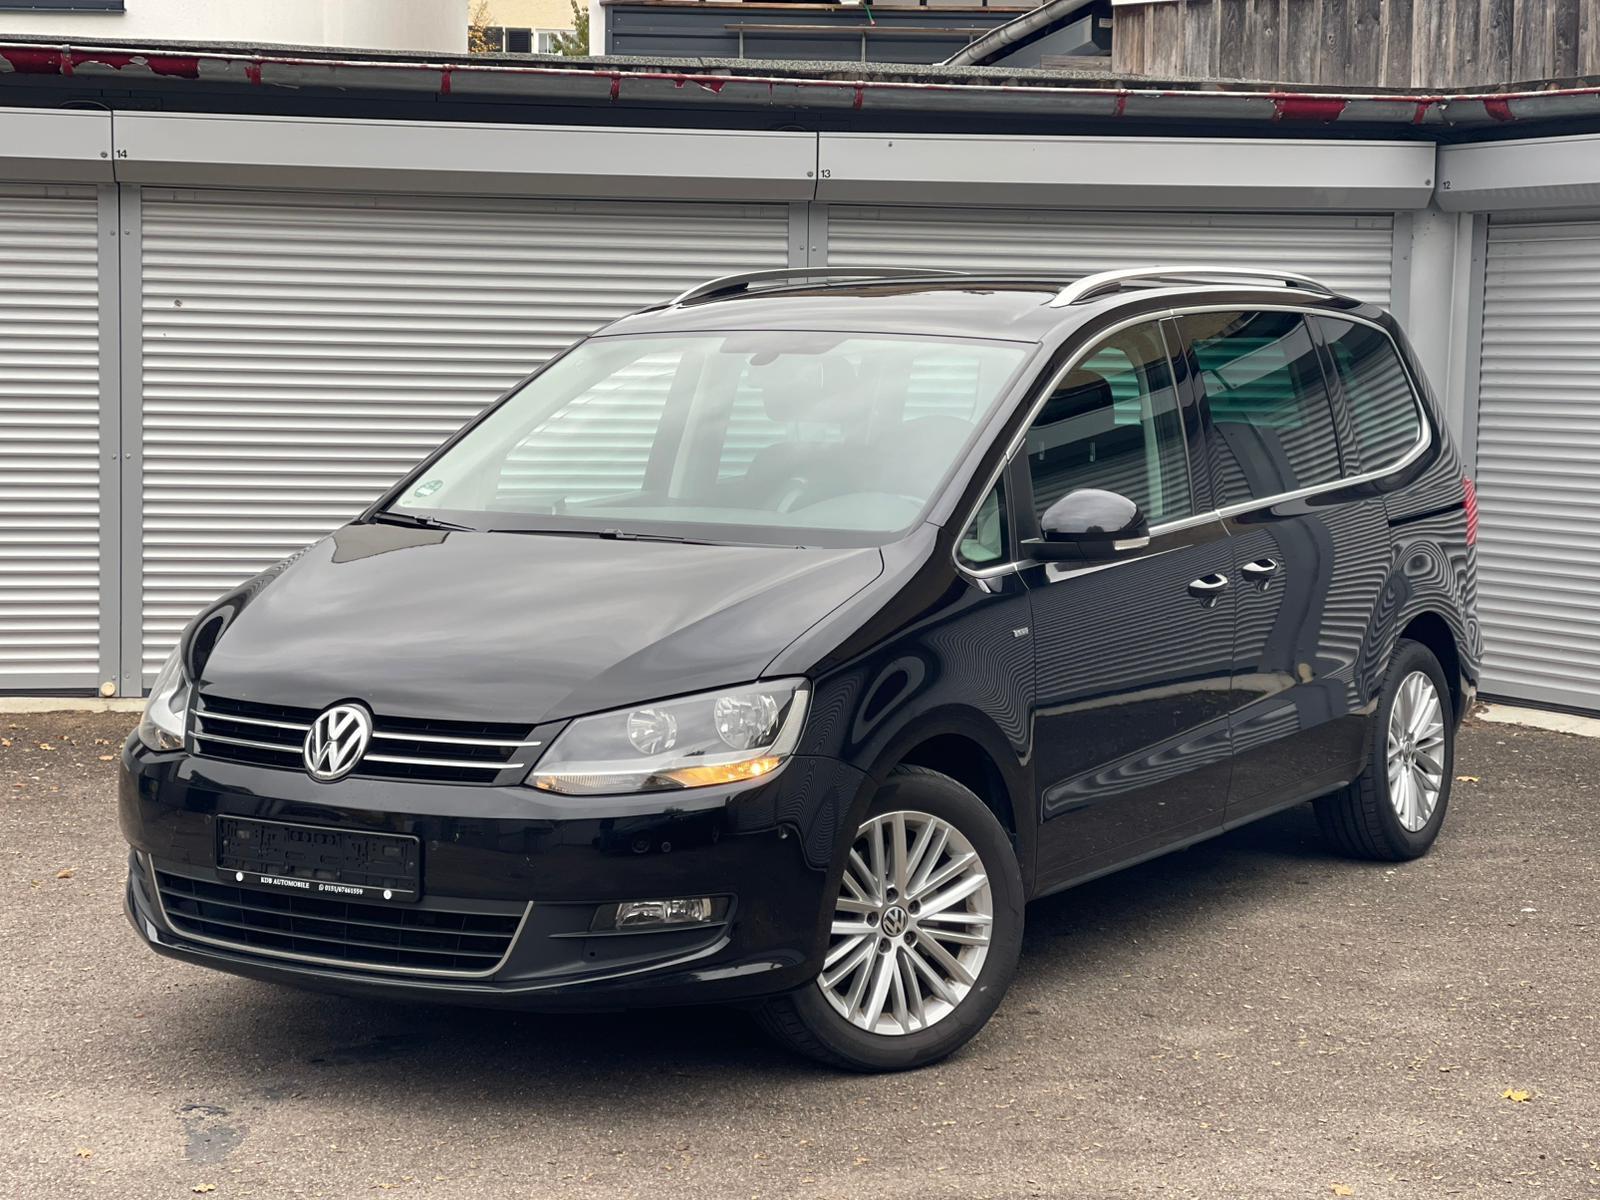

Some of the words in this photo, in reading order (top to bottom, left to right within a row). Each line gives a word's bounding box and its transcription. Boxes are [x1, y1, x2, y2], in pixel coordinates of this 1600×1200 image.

[116, 149, 127, 159] 14
[820, 169, 831, 179] 13
[1442, 180, 1451, 190] 12
[304, 704, 371, 780] VW
[260, 876, 272, 884] KDB
[272, 878, 310, 889] AUTOMOBILE
[881, 905, 908, 937] VW
